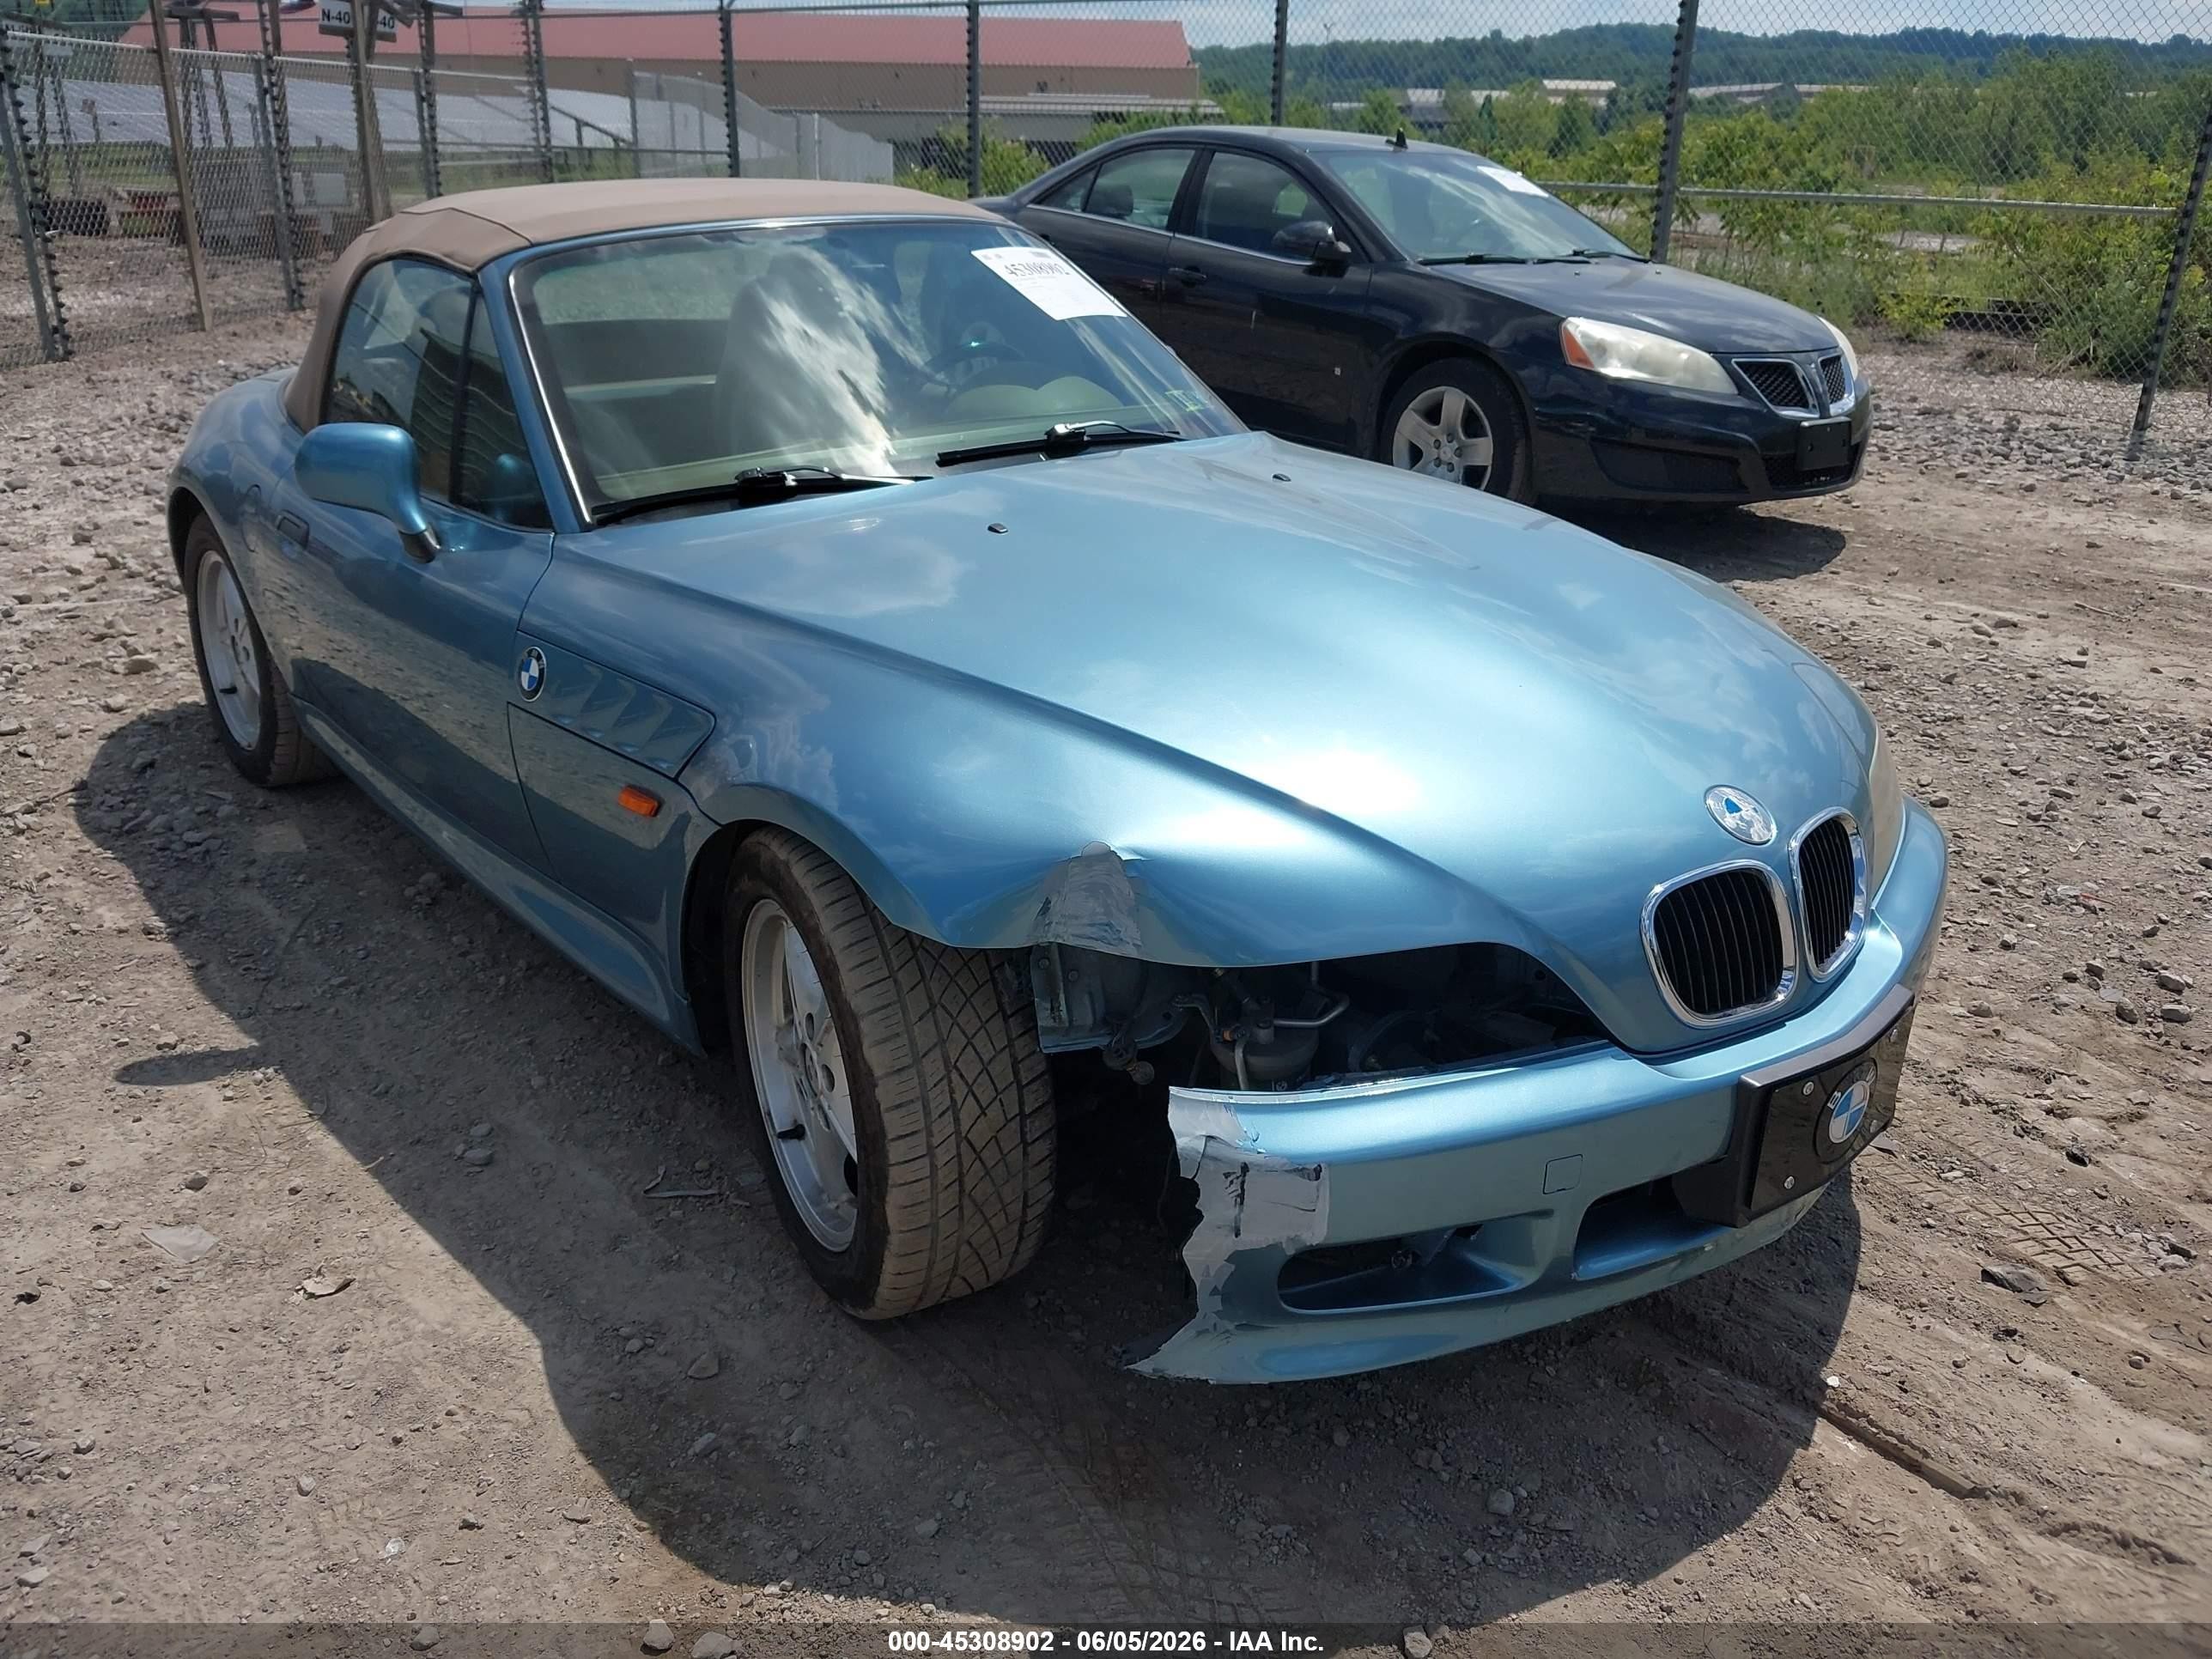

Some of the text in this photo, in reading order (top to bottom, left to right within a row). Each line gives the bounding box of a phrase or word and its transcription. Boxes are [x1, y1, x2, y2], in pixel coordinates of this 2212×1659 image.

[321, 8, 351, 24] N-40
[376, 15, 395, 29] -40
[1826, 1064, 1876, 1109] BW
